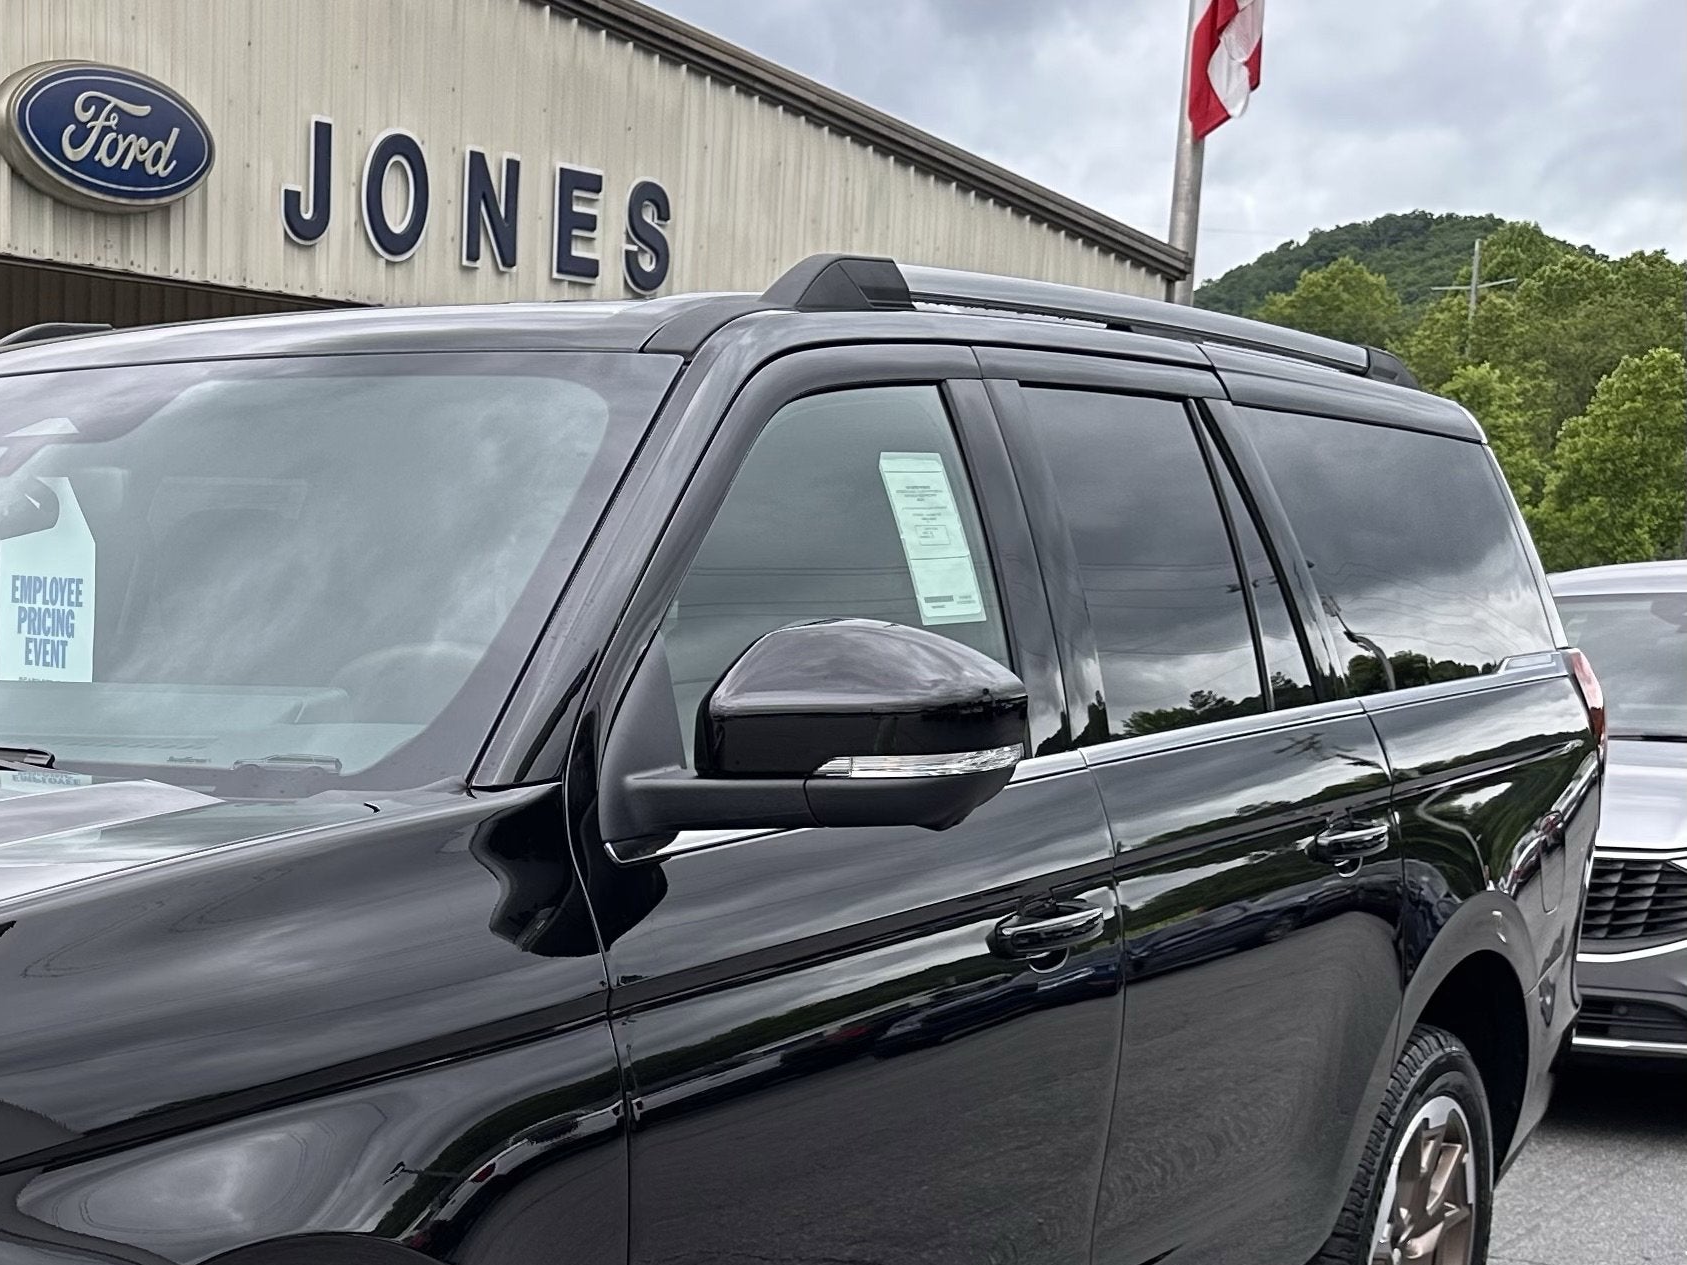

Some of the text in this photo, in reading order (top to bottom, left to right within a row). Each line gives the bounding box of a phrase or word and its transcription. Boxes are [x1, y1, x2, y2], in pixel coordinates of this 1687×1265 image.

[61, 90, 181, 180] Ford
[280, 114, 672, 296] JONES
[11, 574, 84, 608] EMPLOYEE
[17, 605, 75, 639] PRICING
[24, 637, 69, 669] EVENT
